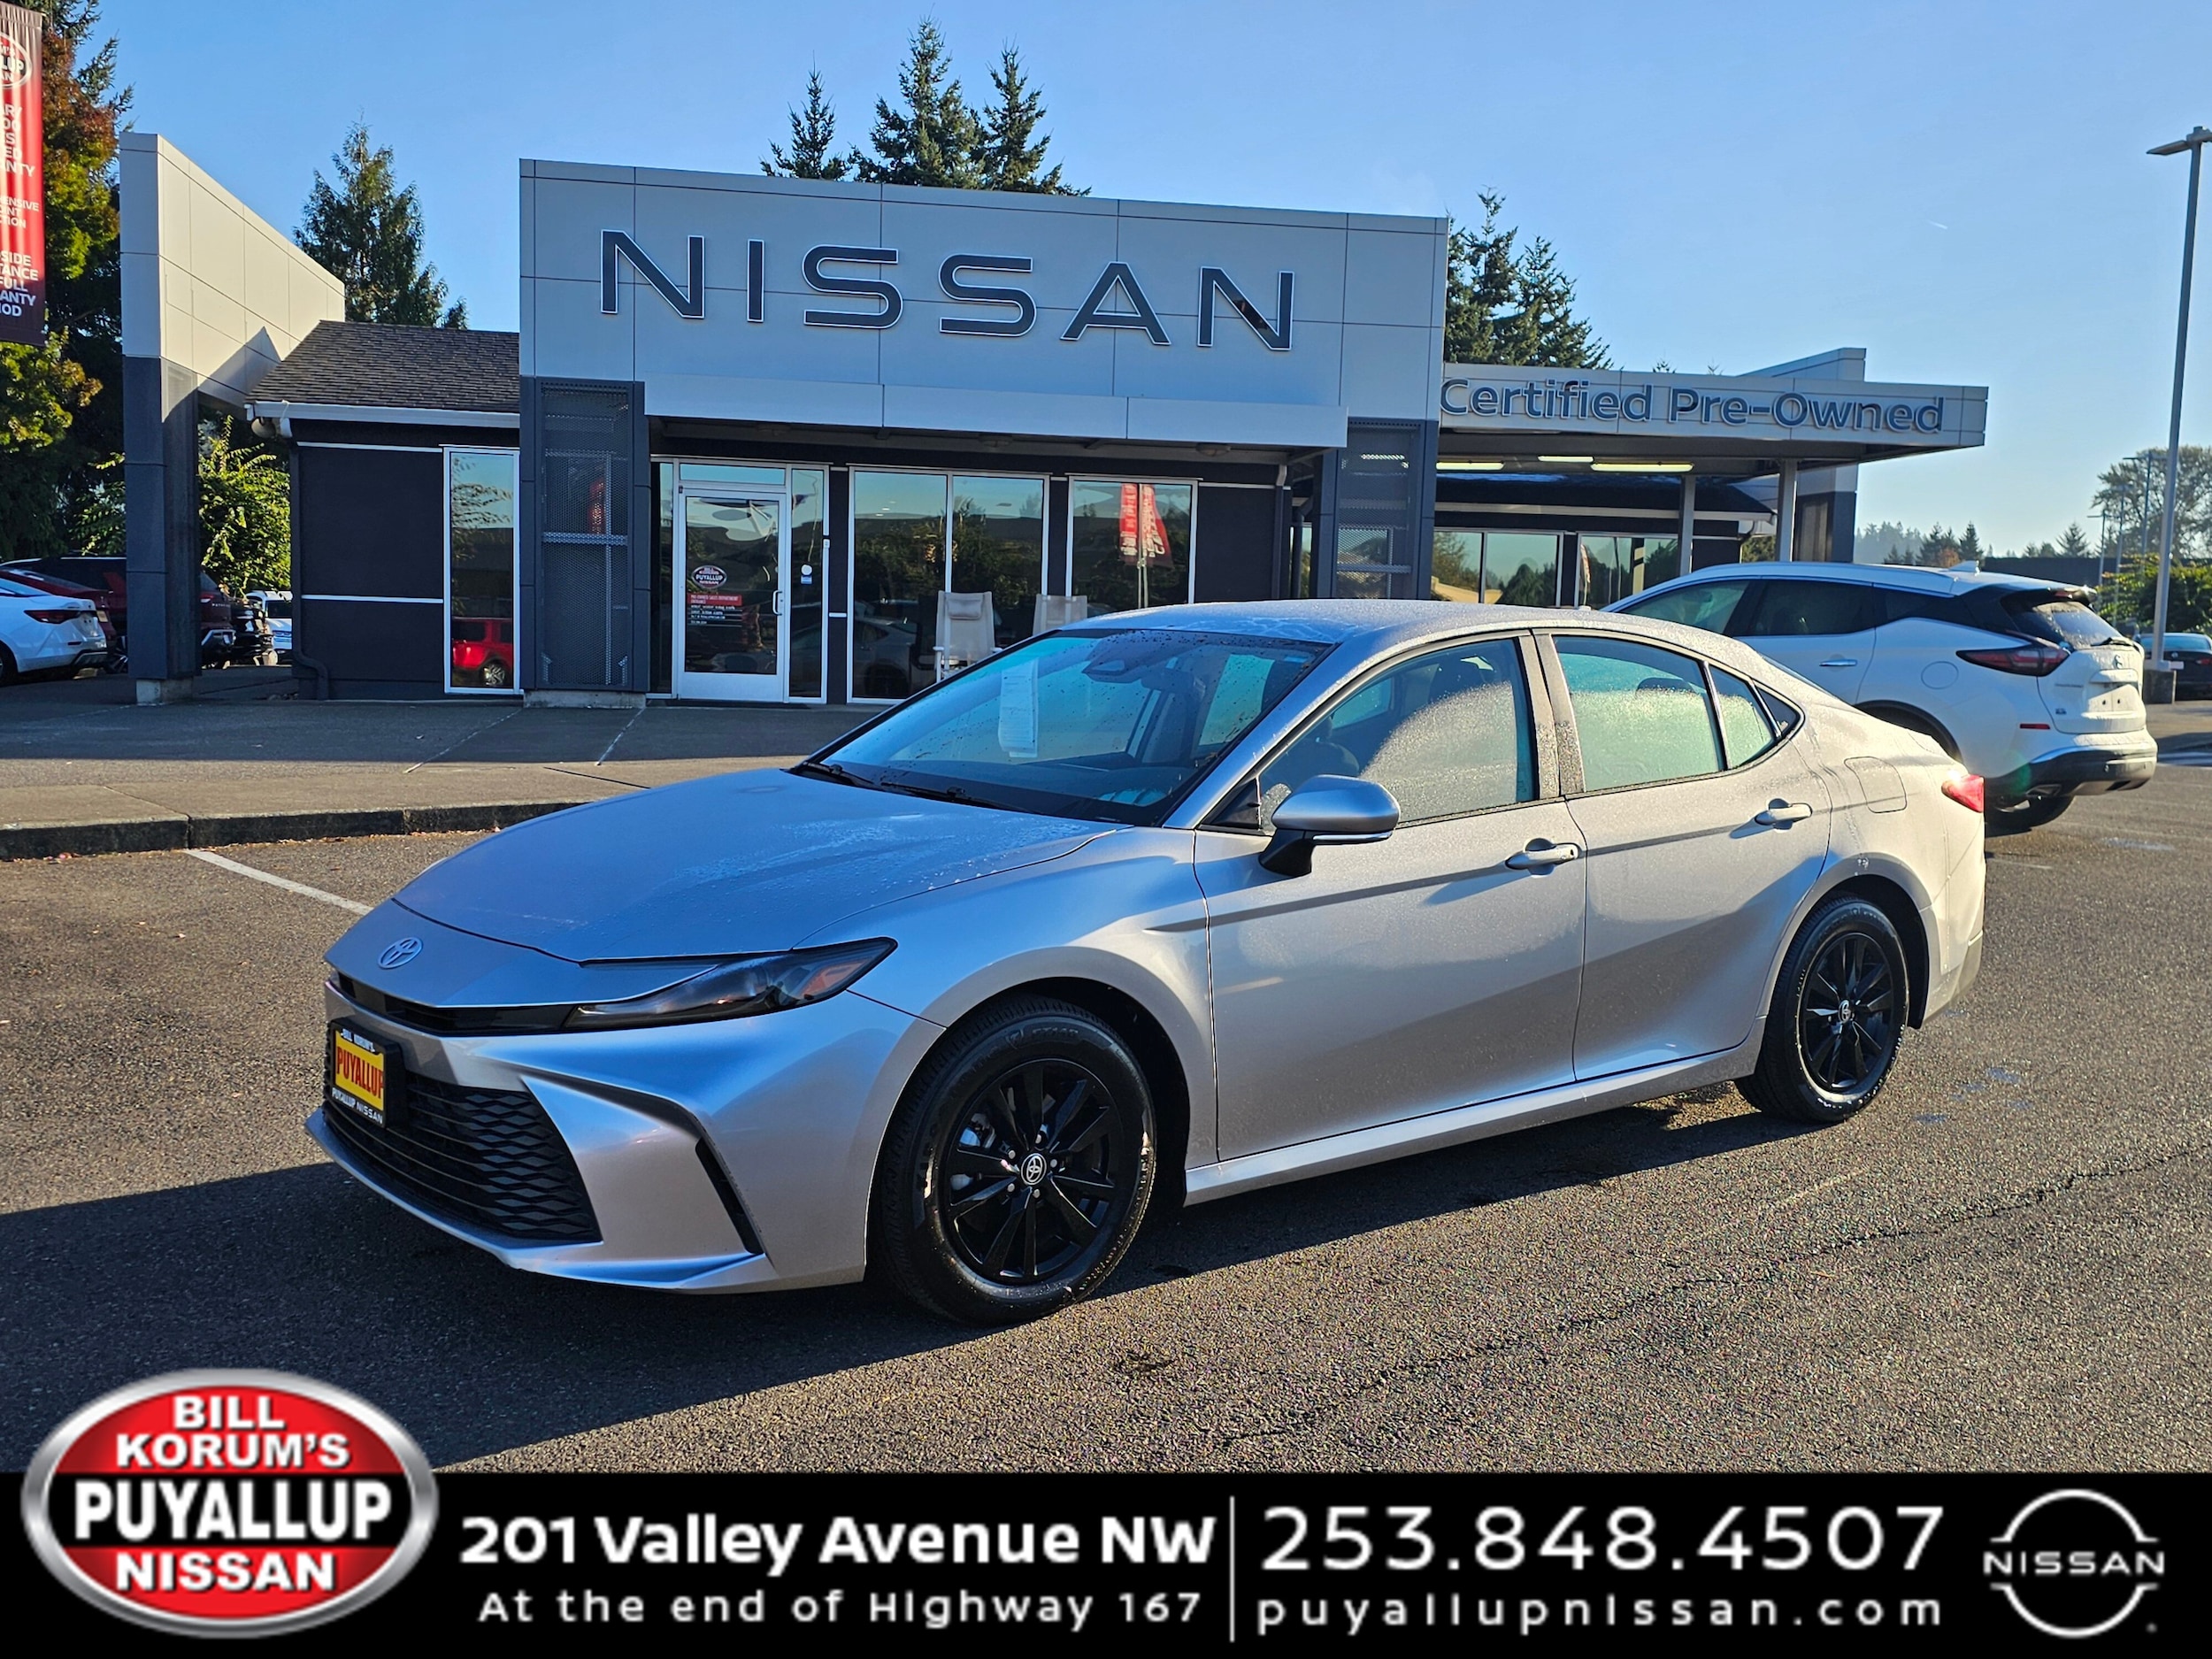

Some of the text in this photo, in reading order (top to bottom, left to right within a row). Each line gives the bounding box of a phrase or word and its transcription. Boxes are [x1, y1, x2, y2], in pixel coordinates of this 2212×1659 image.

[0, 213, 27, 229] TION
[600, 228, 1295, 351] NISSAN
[1440, 378, 1945, 435] Certified Pre-Owned
[357, 1101, 383, 1125] NISSAN
